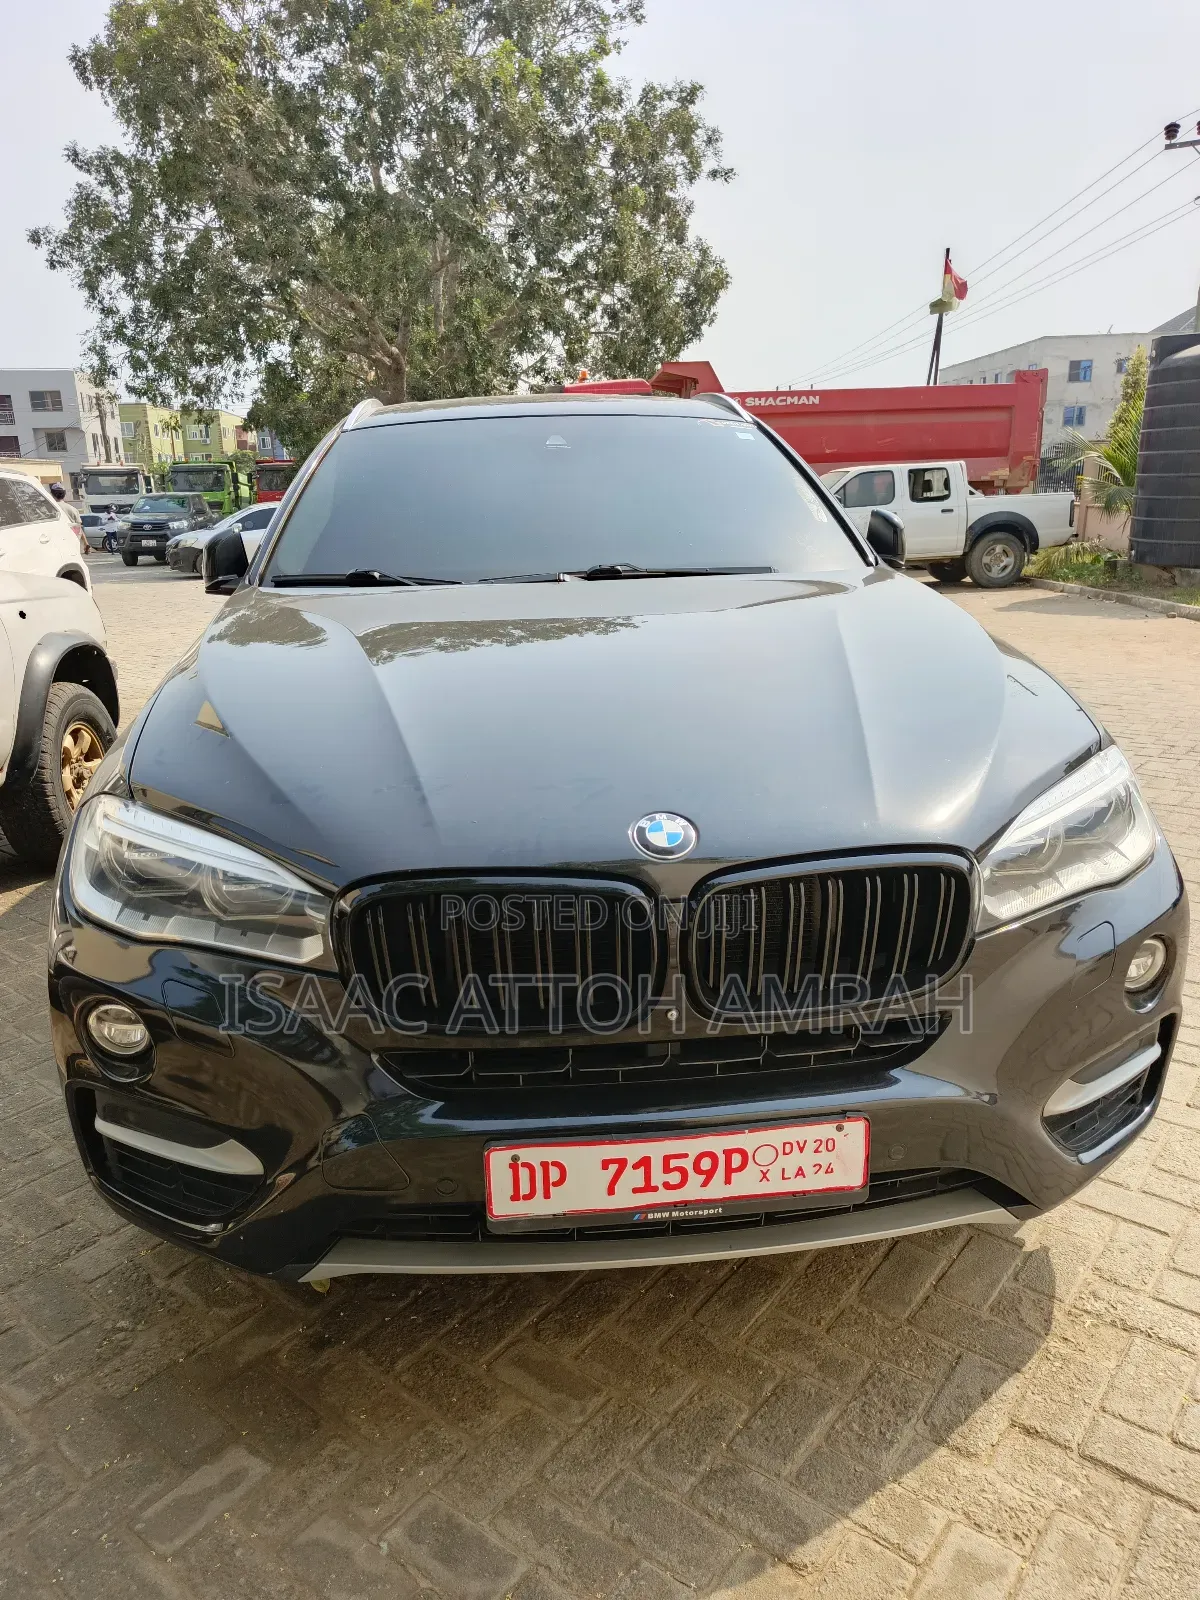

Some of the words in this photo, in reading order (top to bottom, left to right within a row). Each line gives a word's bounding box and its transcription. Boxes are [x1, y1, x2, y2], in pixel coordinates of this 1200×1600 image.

[745, 396, 820, 406] SHACMAN
[638, 813, 688, 828] BMW
[782, 1139, 808, 1156] DV
[813, 1137, 836, 1154] 20
[509, 1160, 567, 1202] DP
[601, 1147, 750, 1197] 7159P
[759, 1168, 771, 1182] X
[781, 1165, 807, 1181] LA
[647, 1211, 670, 1220] BMW
[671, 1207, 723, 1217] Motorsport
